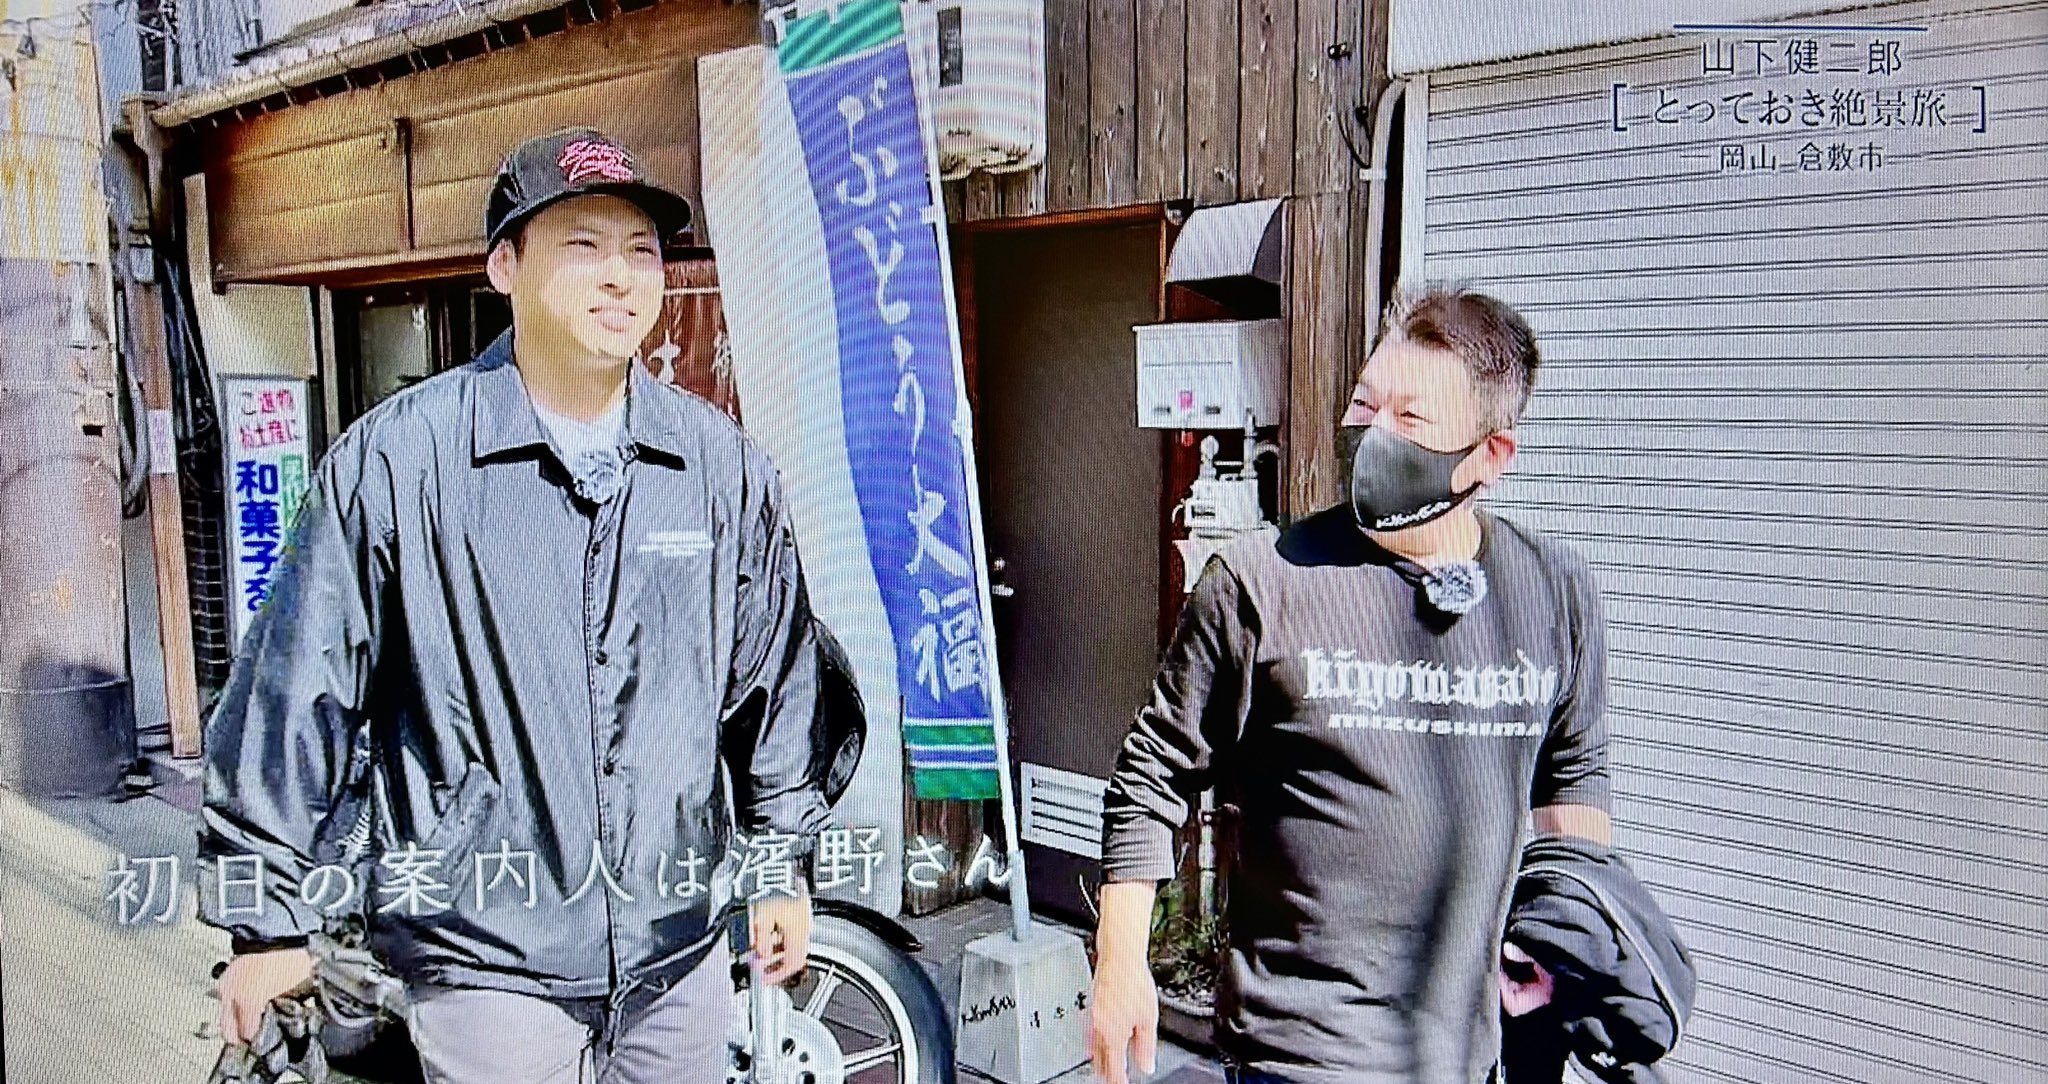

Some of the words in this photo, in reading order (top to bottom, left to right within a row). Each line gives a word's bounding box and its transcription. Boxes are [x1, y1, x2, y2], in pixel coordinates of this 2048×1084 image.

[836, 76, 982, 703] ぶどう大福
